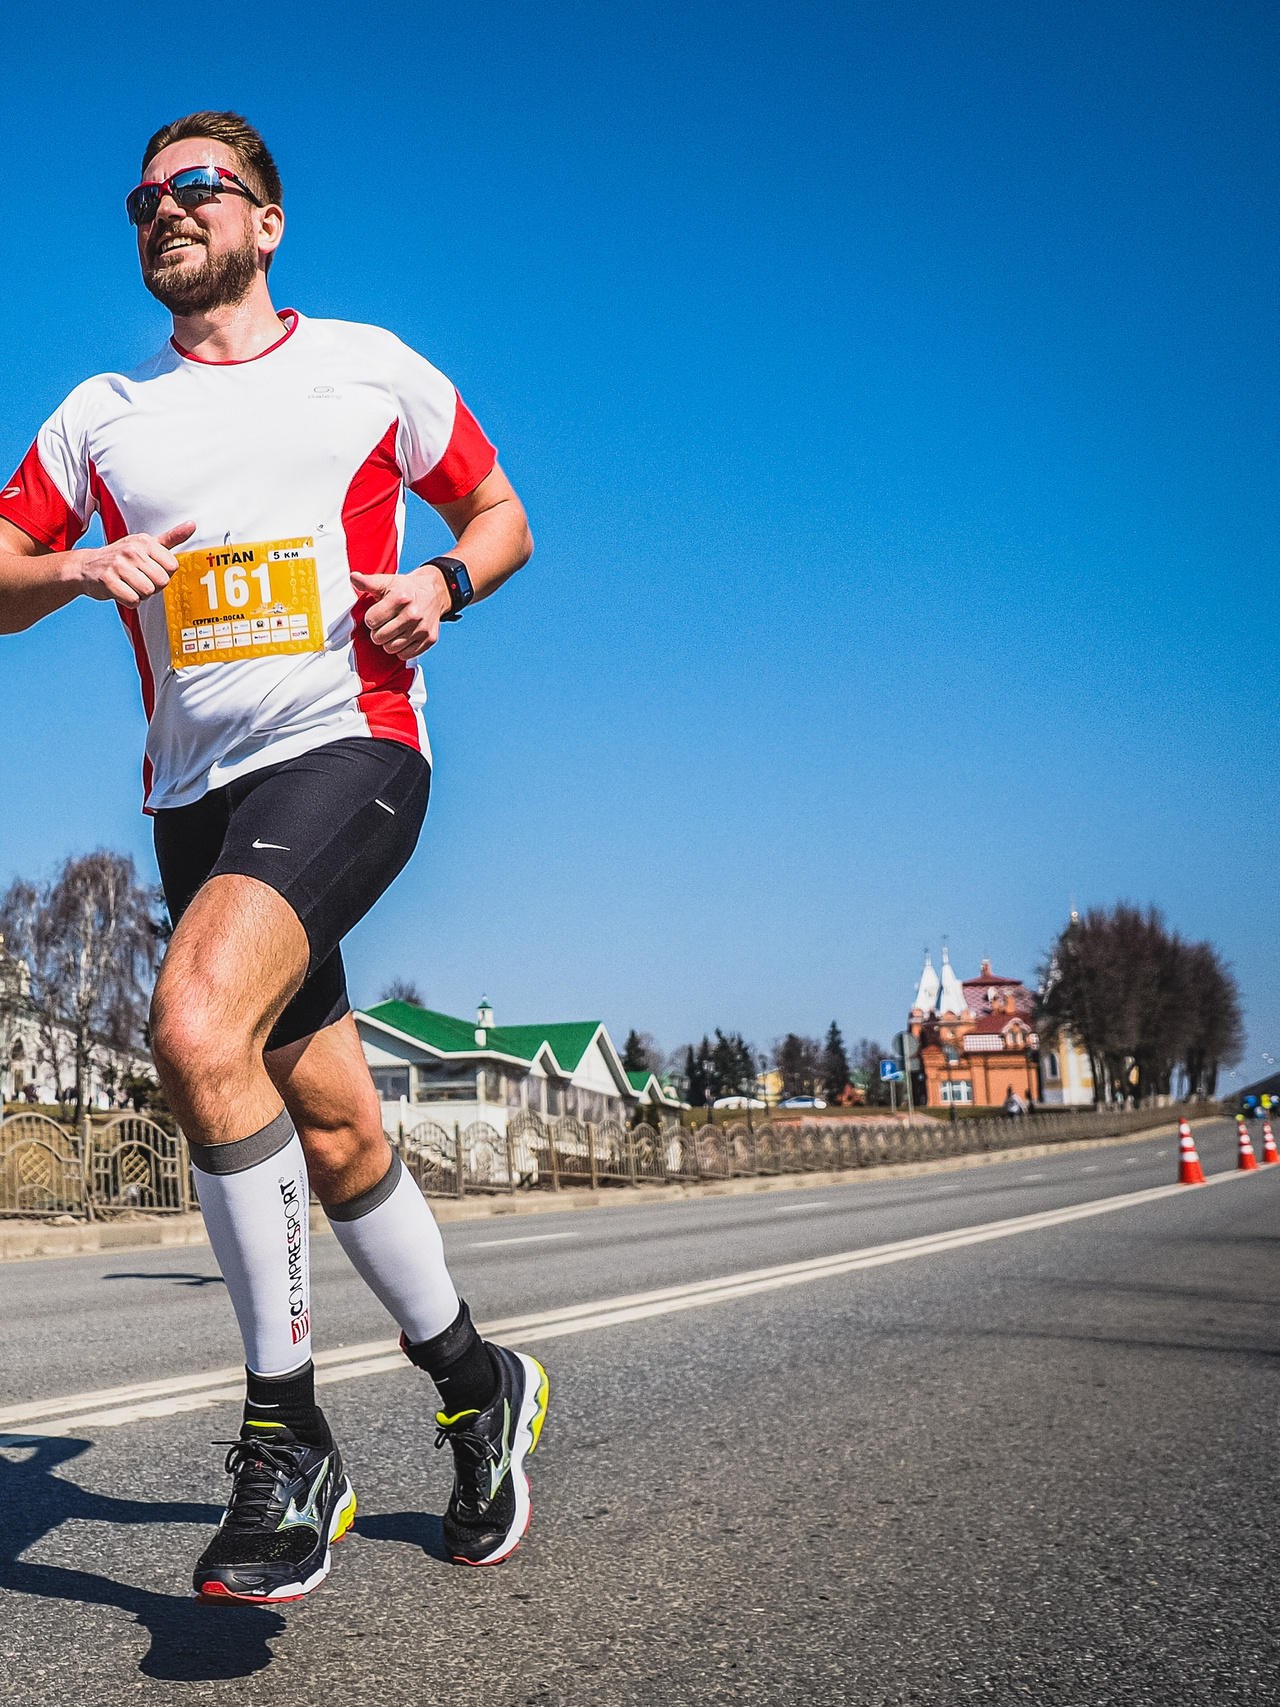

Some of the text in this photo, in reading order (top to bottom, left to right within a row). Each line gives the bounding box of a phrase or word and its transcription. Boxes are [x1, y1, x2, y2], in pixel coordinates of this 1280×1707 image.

[206, 551, 254, 567] TITAN
[273, 551, 280, 560] 5
[200, 563, 272, 610] 161
